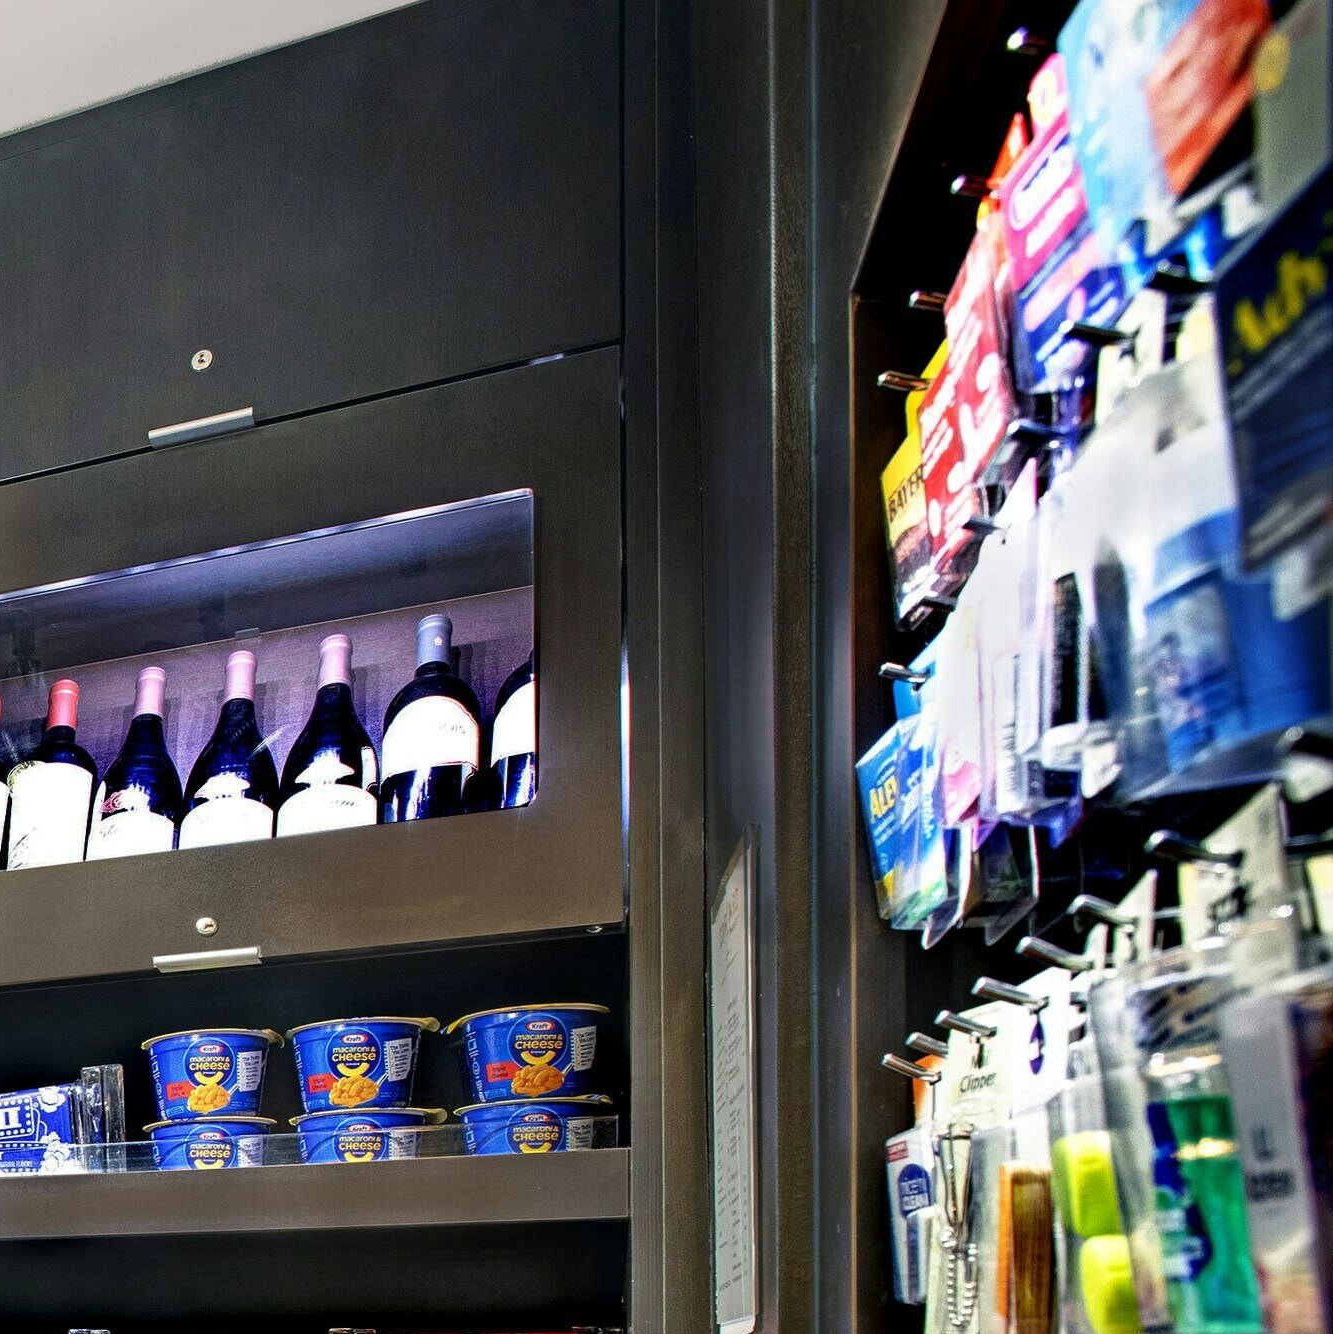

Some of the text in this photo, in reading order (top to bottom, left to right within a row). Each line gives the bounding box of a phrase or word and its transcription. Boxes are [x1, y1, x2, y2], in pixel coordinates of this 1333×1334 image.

[531, 1022, 549, 1031] Kraft
[345, 1035, 363, 1044] Kraft
[515, 1034, 556, 1042] macaroni
[332, 1046, 369, 1054] macaroni
[189, 1056, 224, 1064] macaroni
[959, 1071, 997, 1093] Clipper
